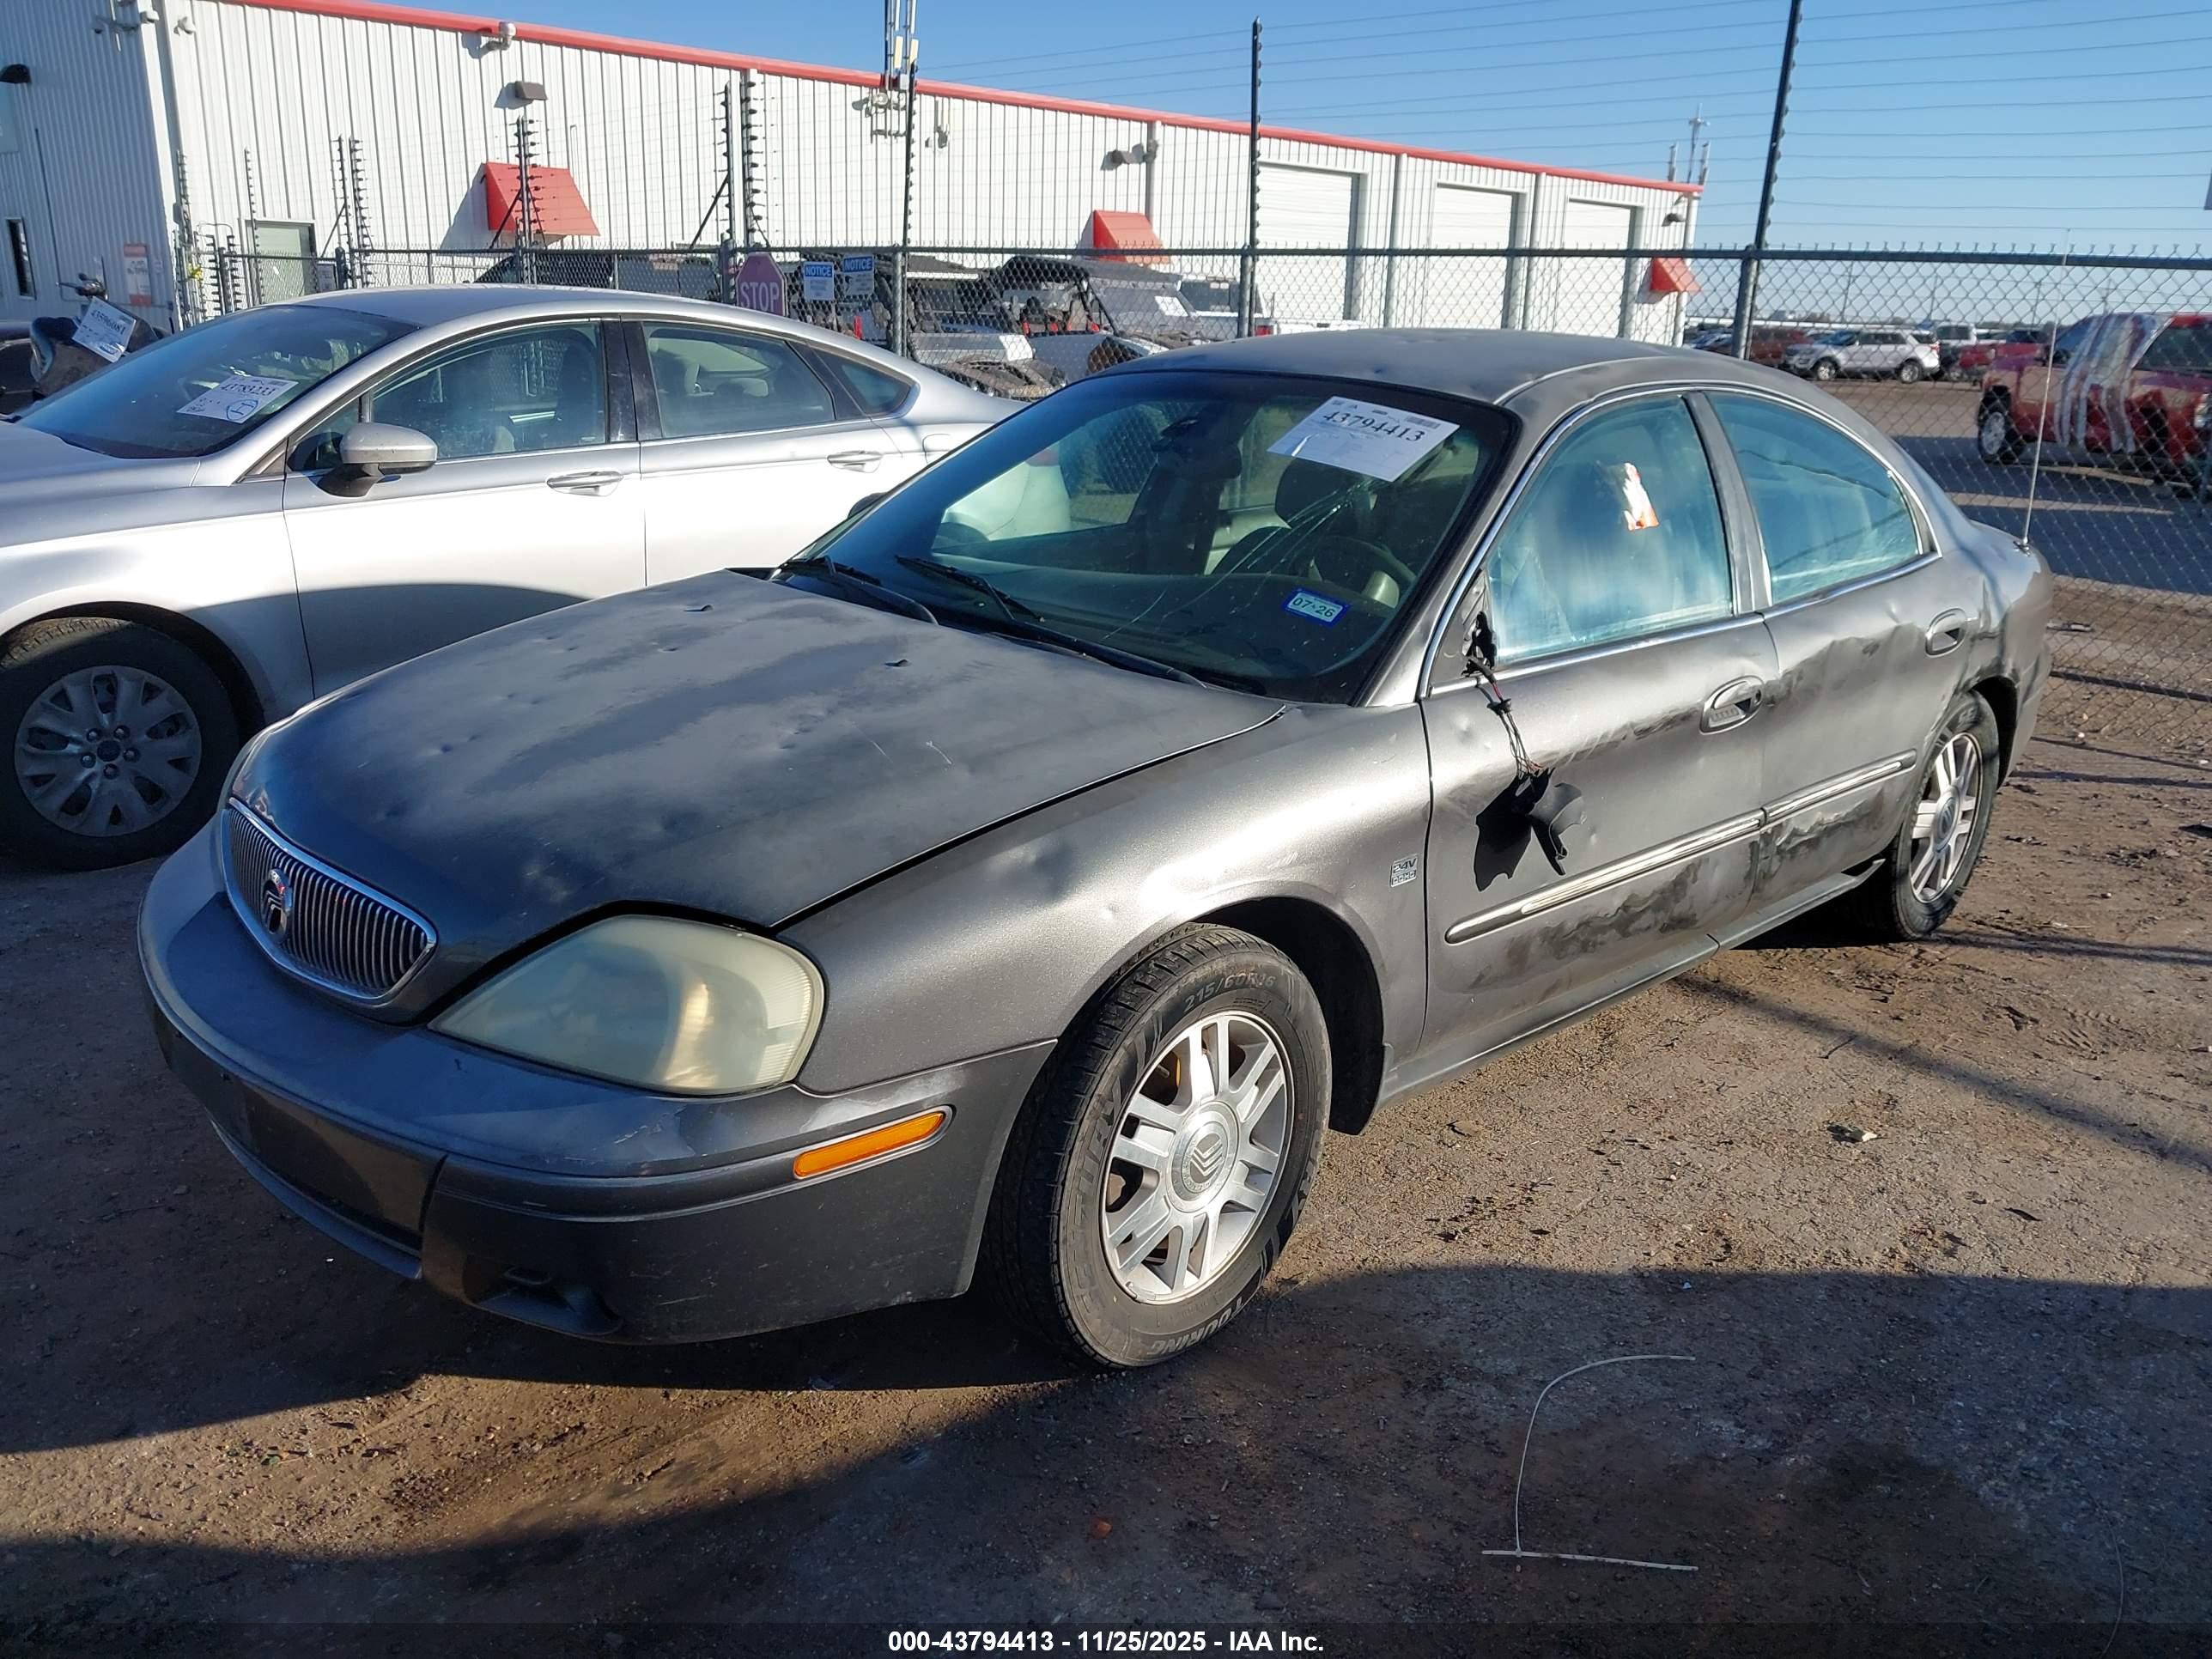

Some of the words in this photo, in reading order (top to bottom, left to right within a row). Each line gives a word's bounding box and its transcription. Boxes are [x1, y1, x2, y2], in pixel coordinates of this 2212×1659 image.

[805, 264, 832, 277] NOTICE
[844, 258, 872, 271] NOTICE
[739, 282, 780, 313] STOP
[1323, 410, 1425, 442] 43794413
[1146, 1296, 1243, 1356] TOURING
